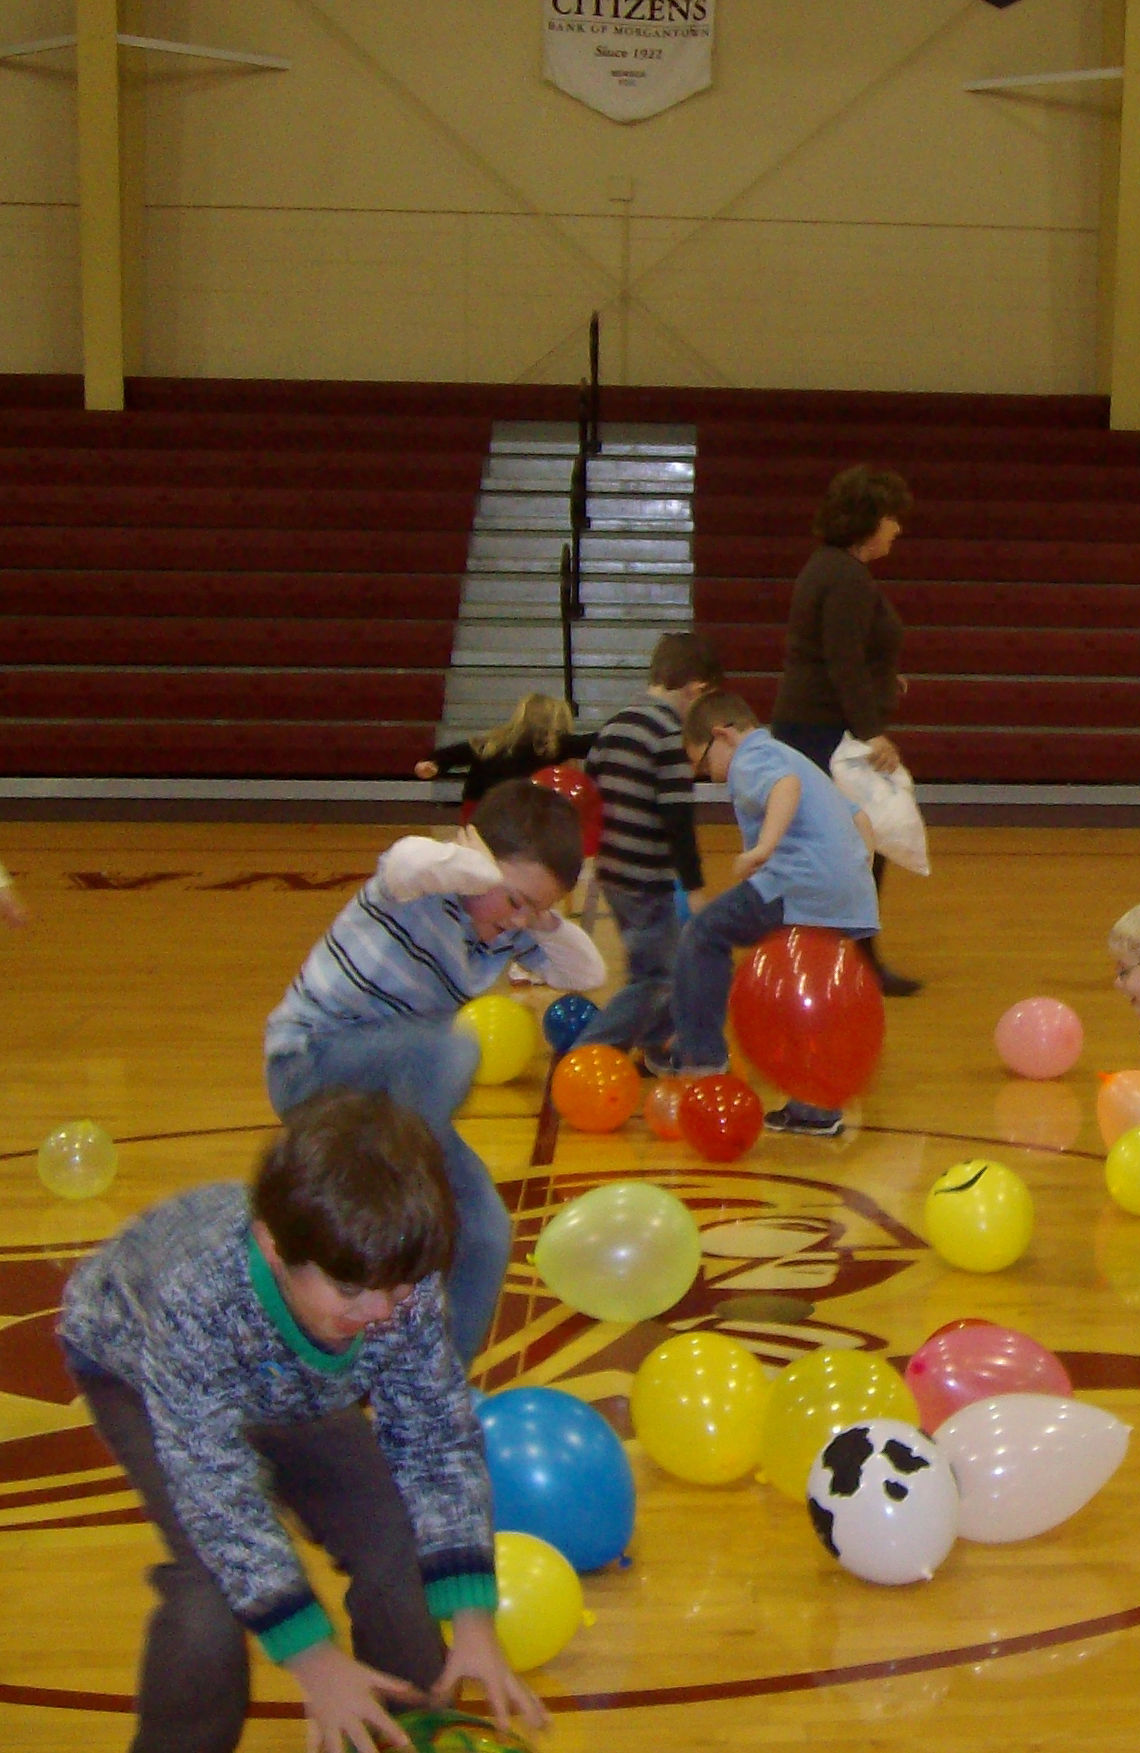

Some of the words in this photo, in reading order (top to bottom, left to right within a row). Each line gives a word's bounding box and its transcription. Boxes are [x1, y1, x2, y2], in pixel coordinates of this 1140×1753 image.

[552, 0, 707, 21] CITIZENS
[548, 21, 586, 33] BANK
[590, 25, 608, 33] OF
[613, 26, 710, 38] MORGANTOWN
[594, 45, 628, 58] Since
